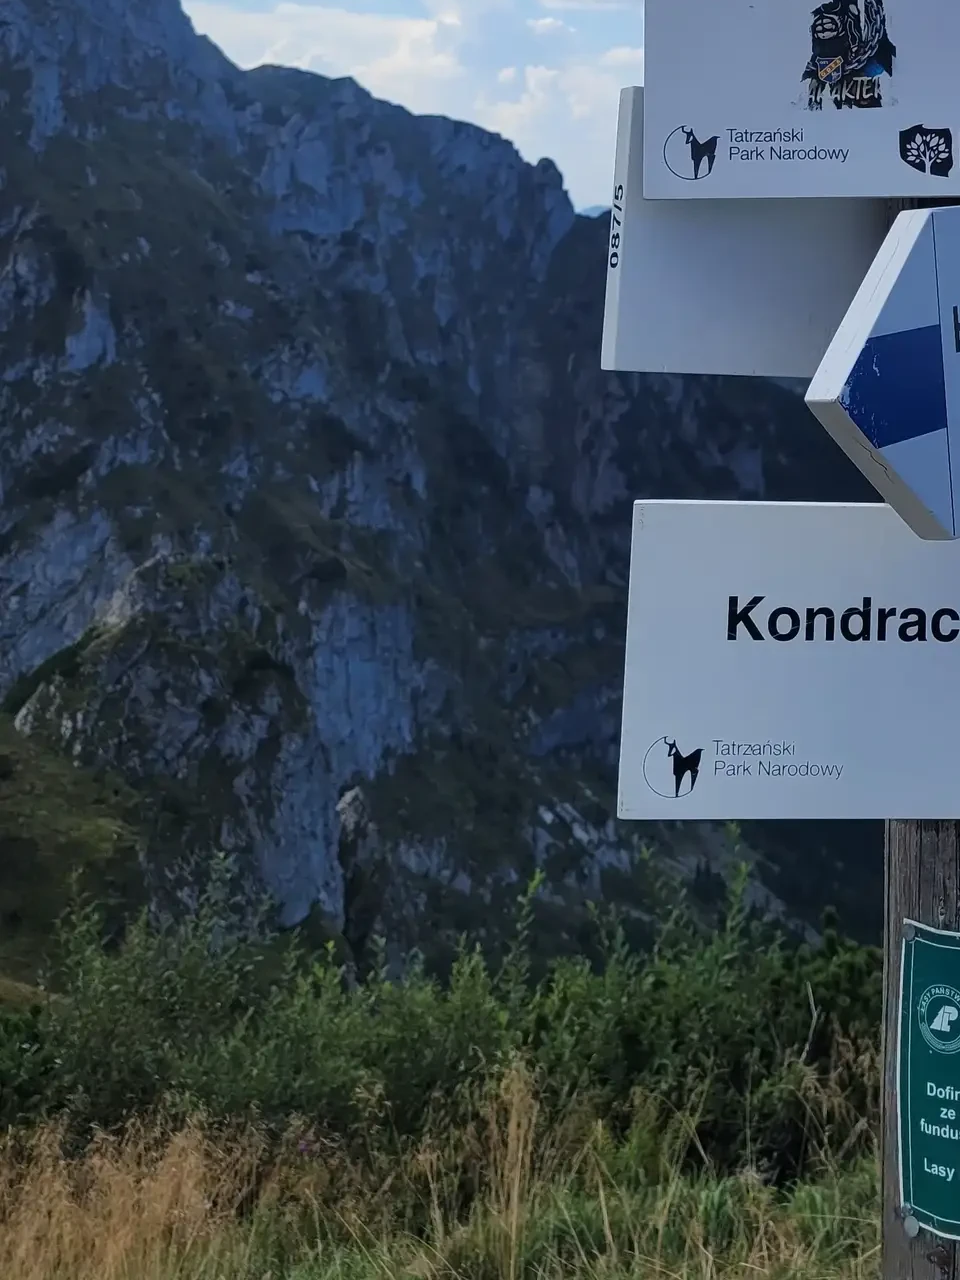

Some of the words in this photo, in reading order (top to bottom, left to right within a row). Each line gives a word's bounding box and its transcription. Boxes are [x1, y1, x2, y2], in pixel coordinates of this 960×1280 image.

[726, 127, 804, 143] Tatrzański
[729, 146, 765, 161] Park
[770, 145, 850, 163] Narodowy
[610, 184, 624, 268] 087/5
[713, 739, 796, 757] Tatrzański
[714, 761, 752, 777] Park
[758, 761, 844, 781] Narodowy
[939, 1107, 956, 1120] ze
[924, 1157, 955, 1182] Lasy
